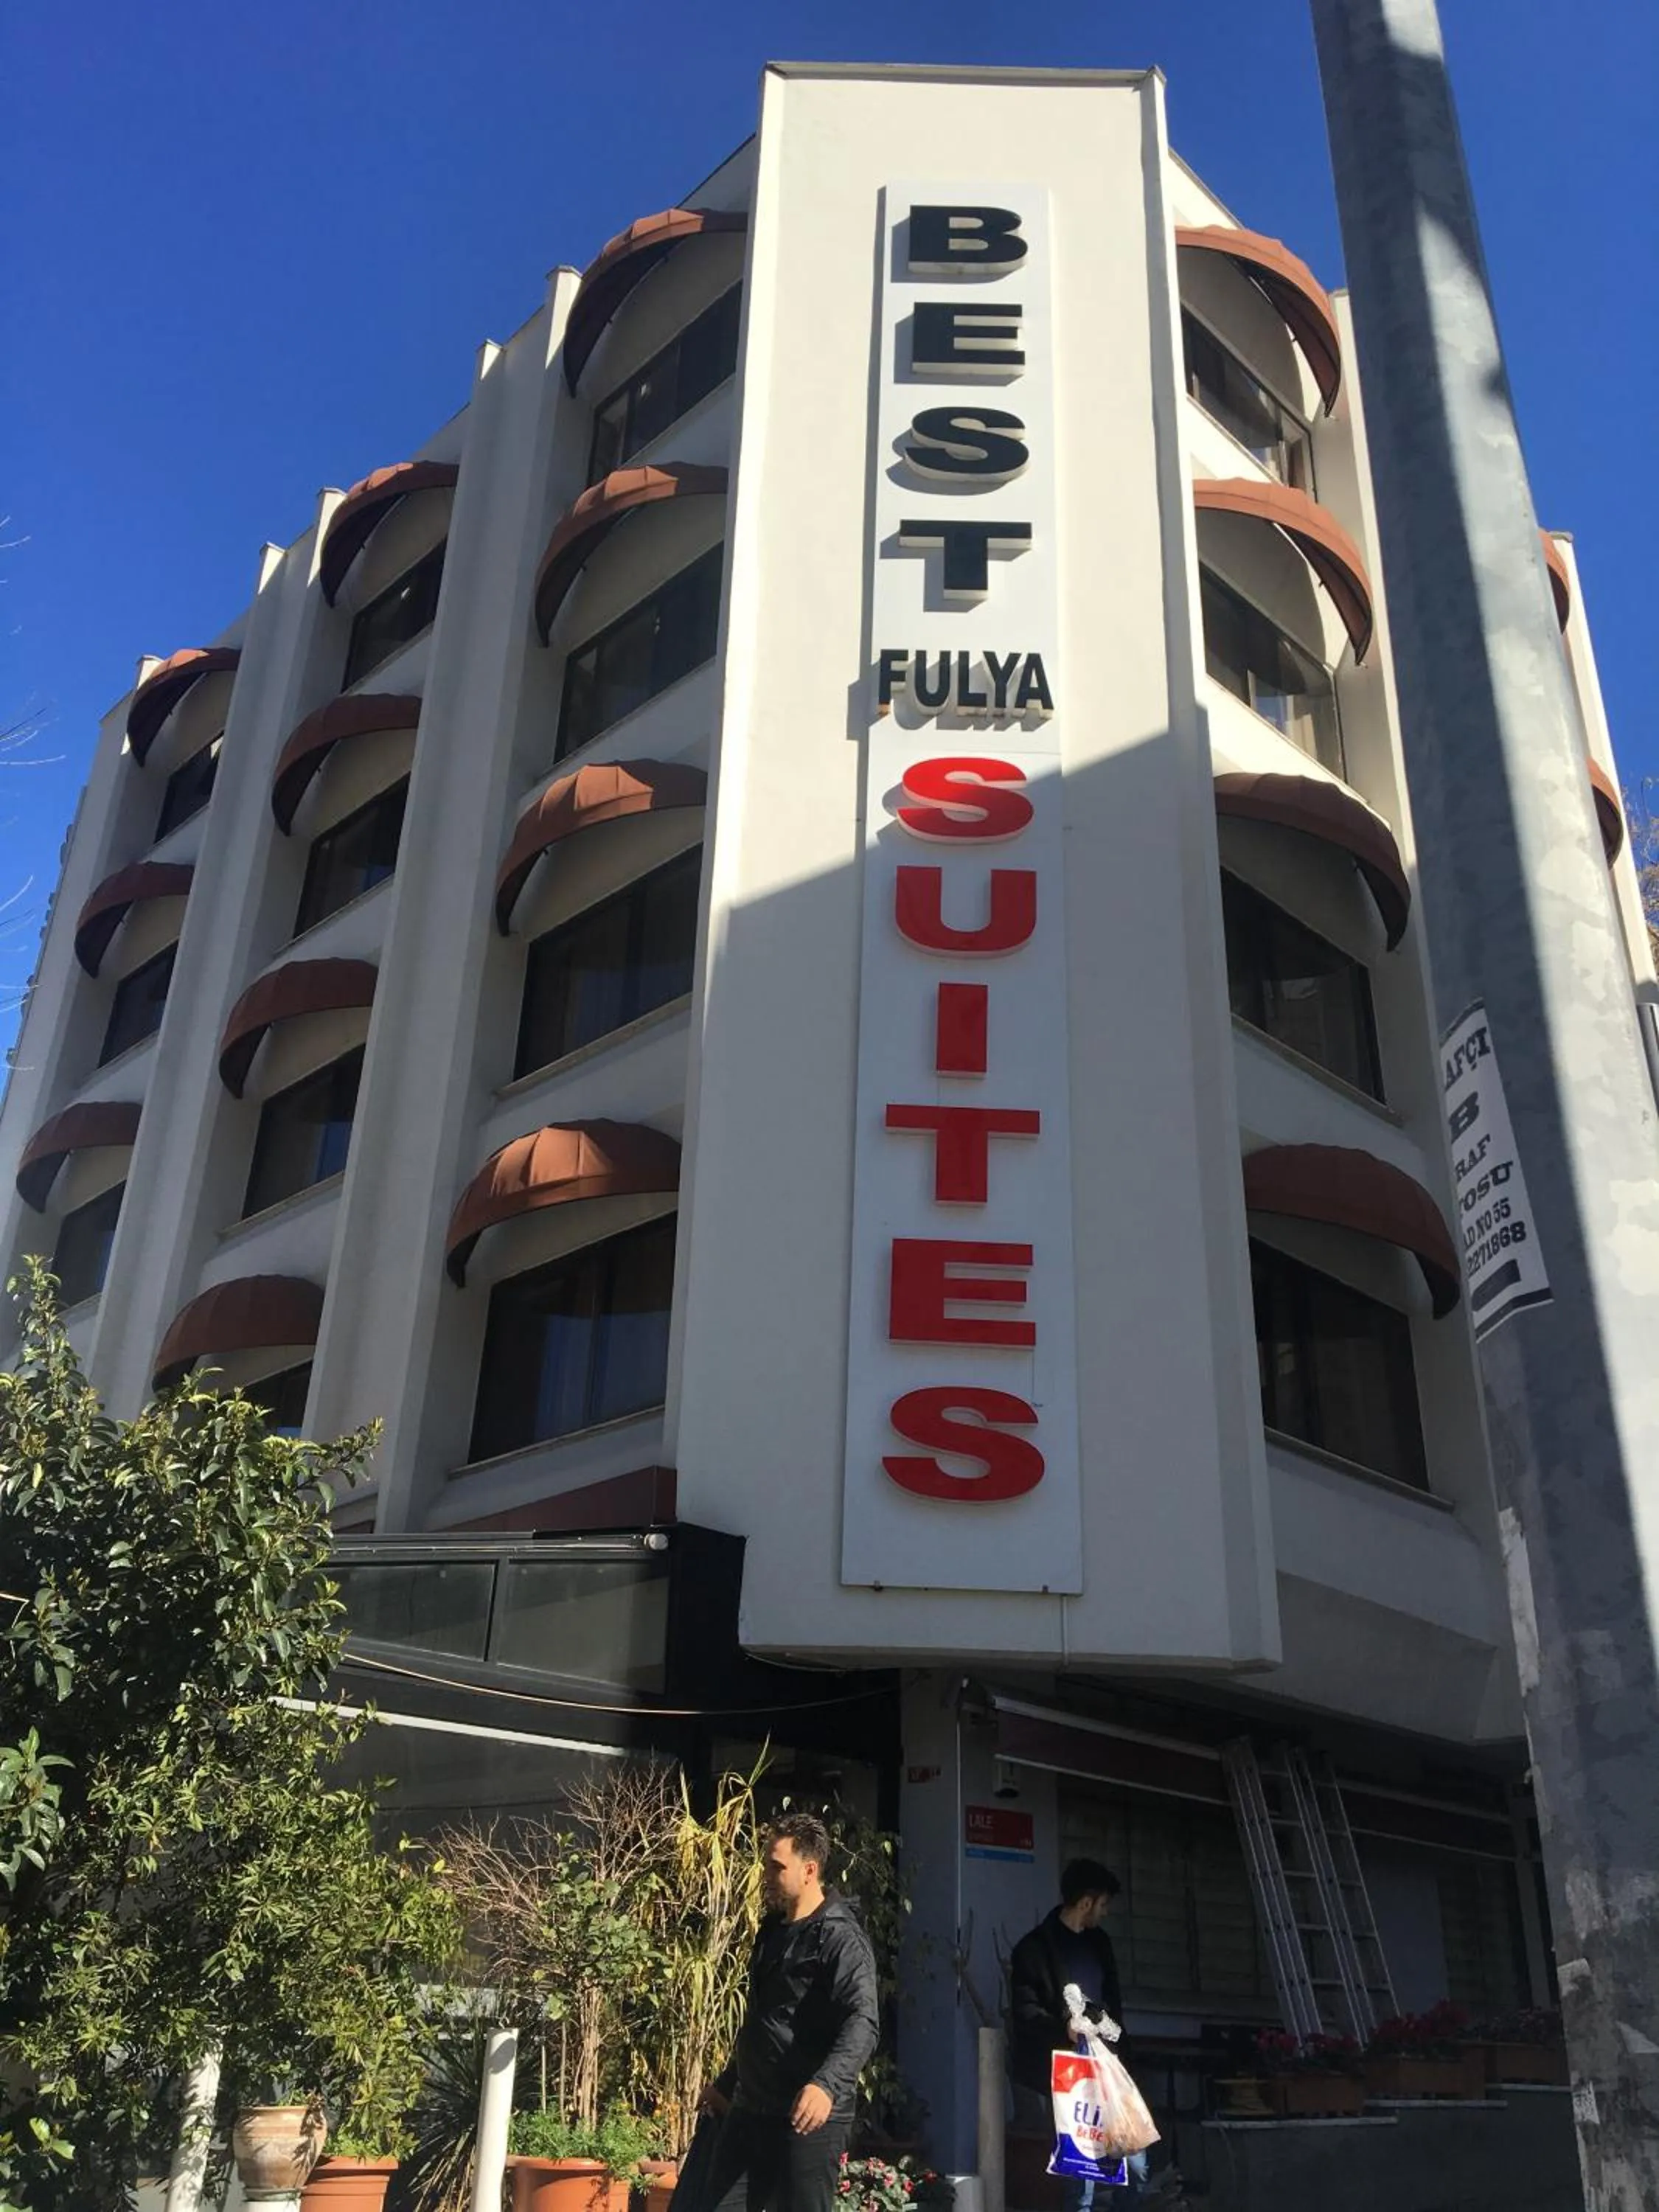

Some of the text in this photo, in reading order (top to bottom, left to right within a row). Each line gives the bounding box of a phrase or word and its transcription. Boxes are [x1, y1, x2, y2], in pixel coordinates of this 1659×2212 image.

[897, 205, 1032, 597] BEST
[878, 649, 1054, 712] FULYA
[883, 756, 1046, 1503] SUITES
